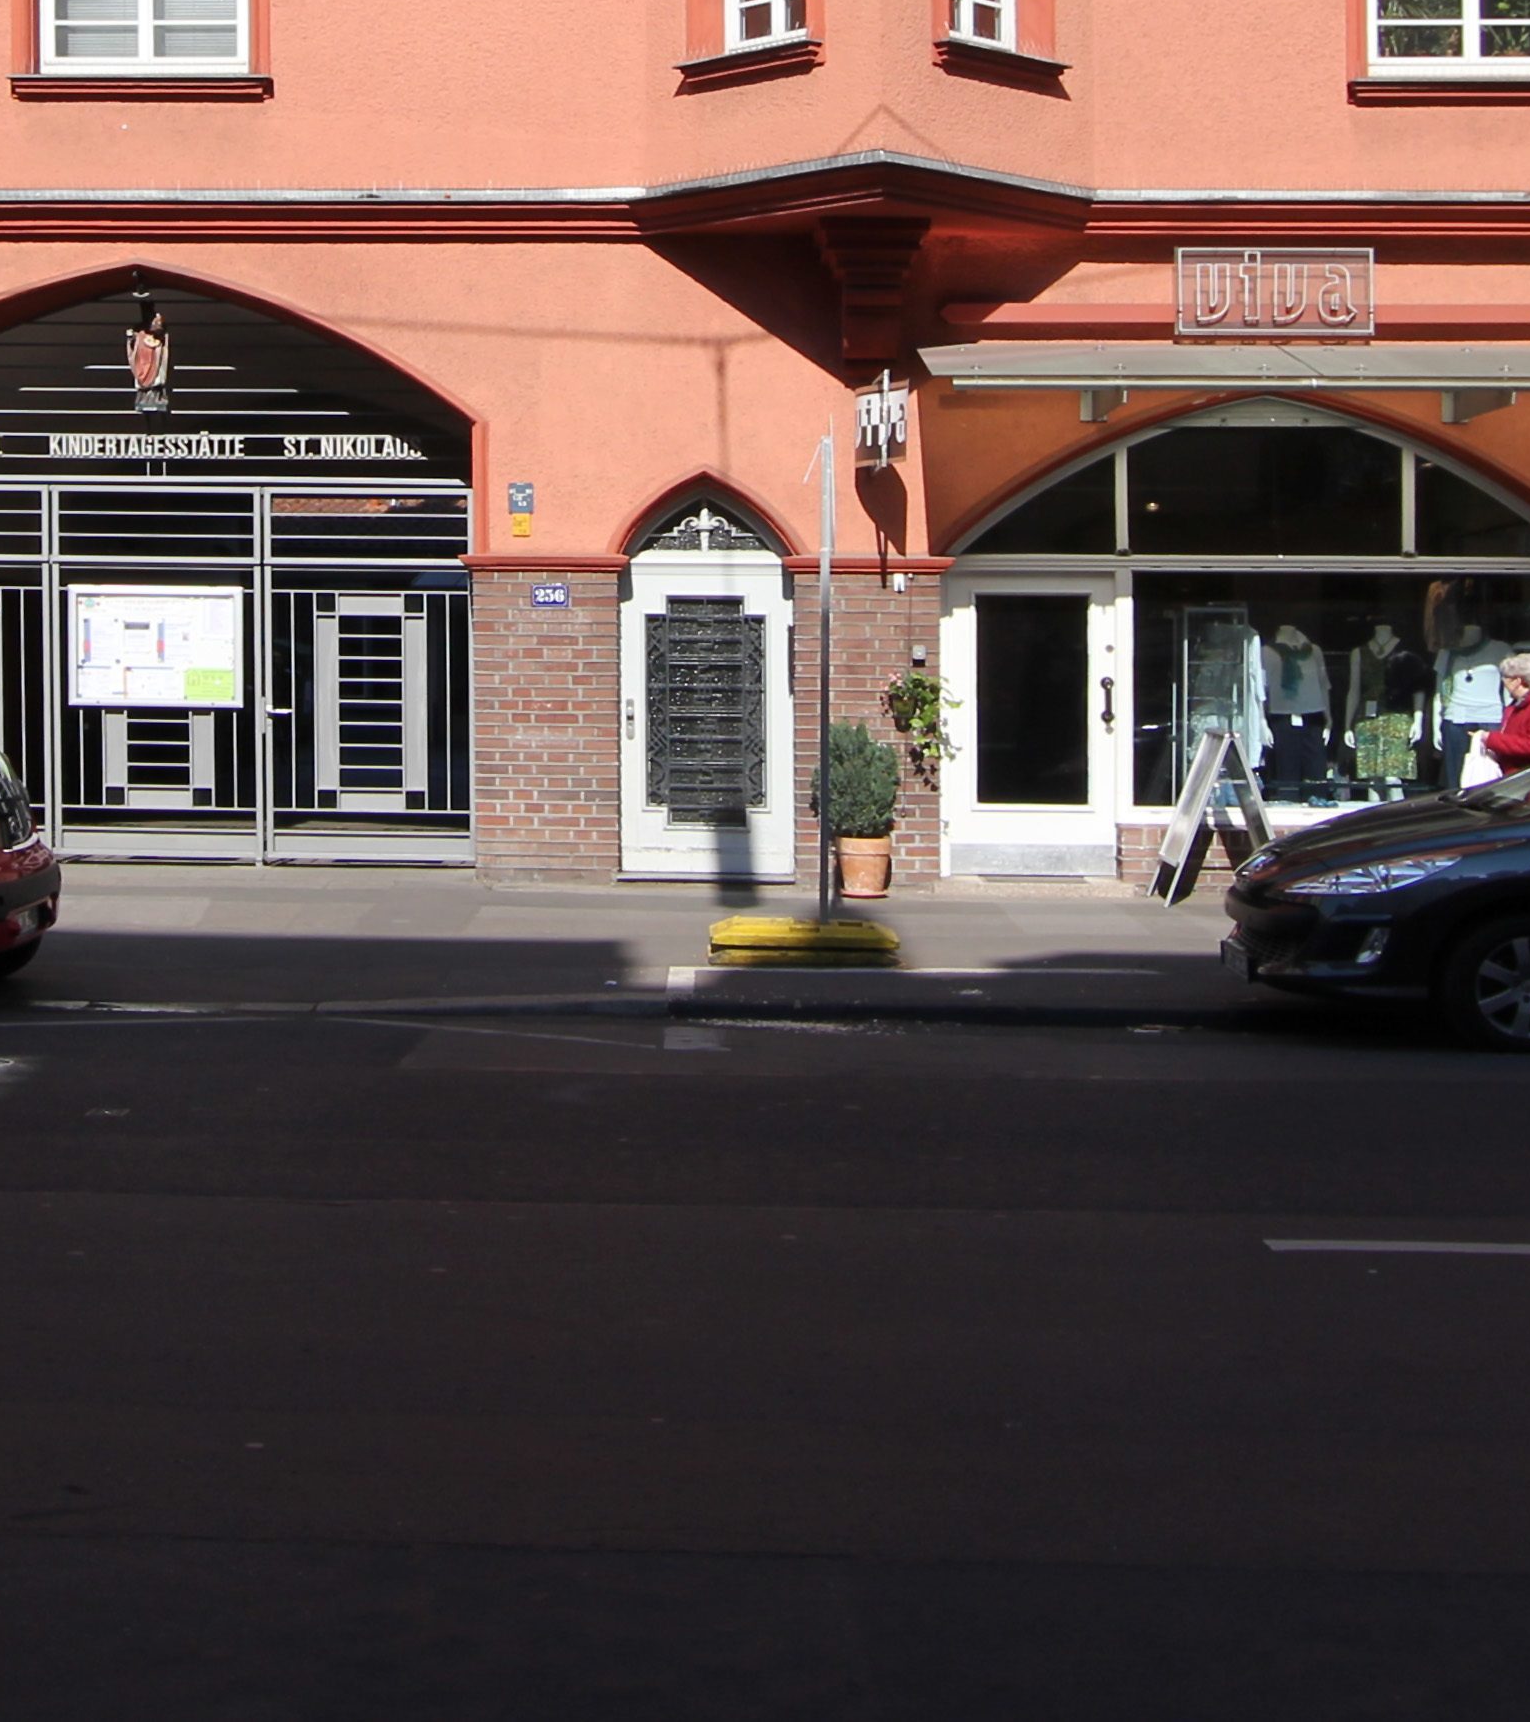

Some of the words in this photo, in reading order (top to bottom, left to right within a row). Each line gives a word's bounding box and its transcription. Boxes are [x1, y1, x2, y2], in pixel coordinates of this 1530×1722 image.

[1195, 251, 1358, 325] viva
[49, 431, 245, 457] KINDERTAGESSTÄTTE
[283, 436, 314, 458] ST.
[534, 588, 565, 603] 256
